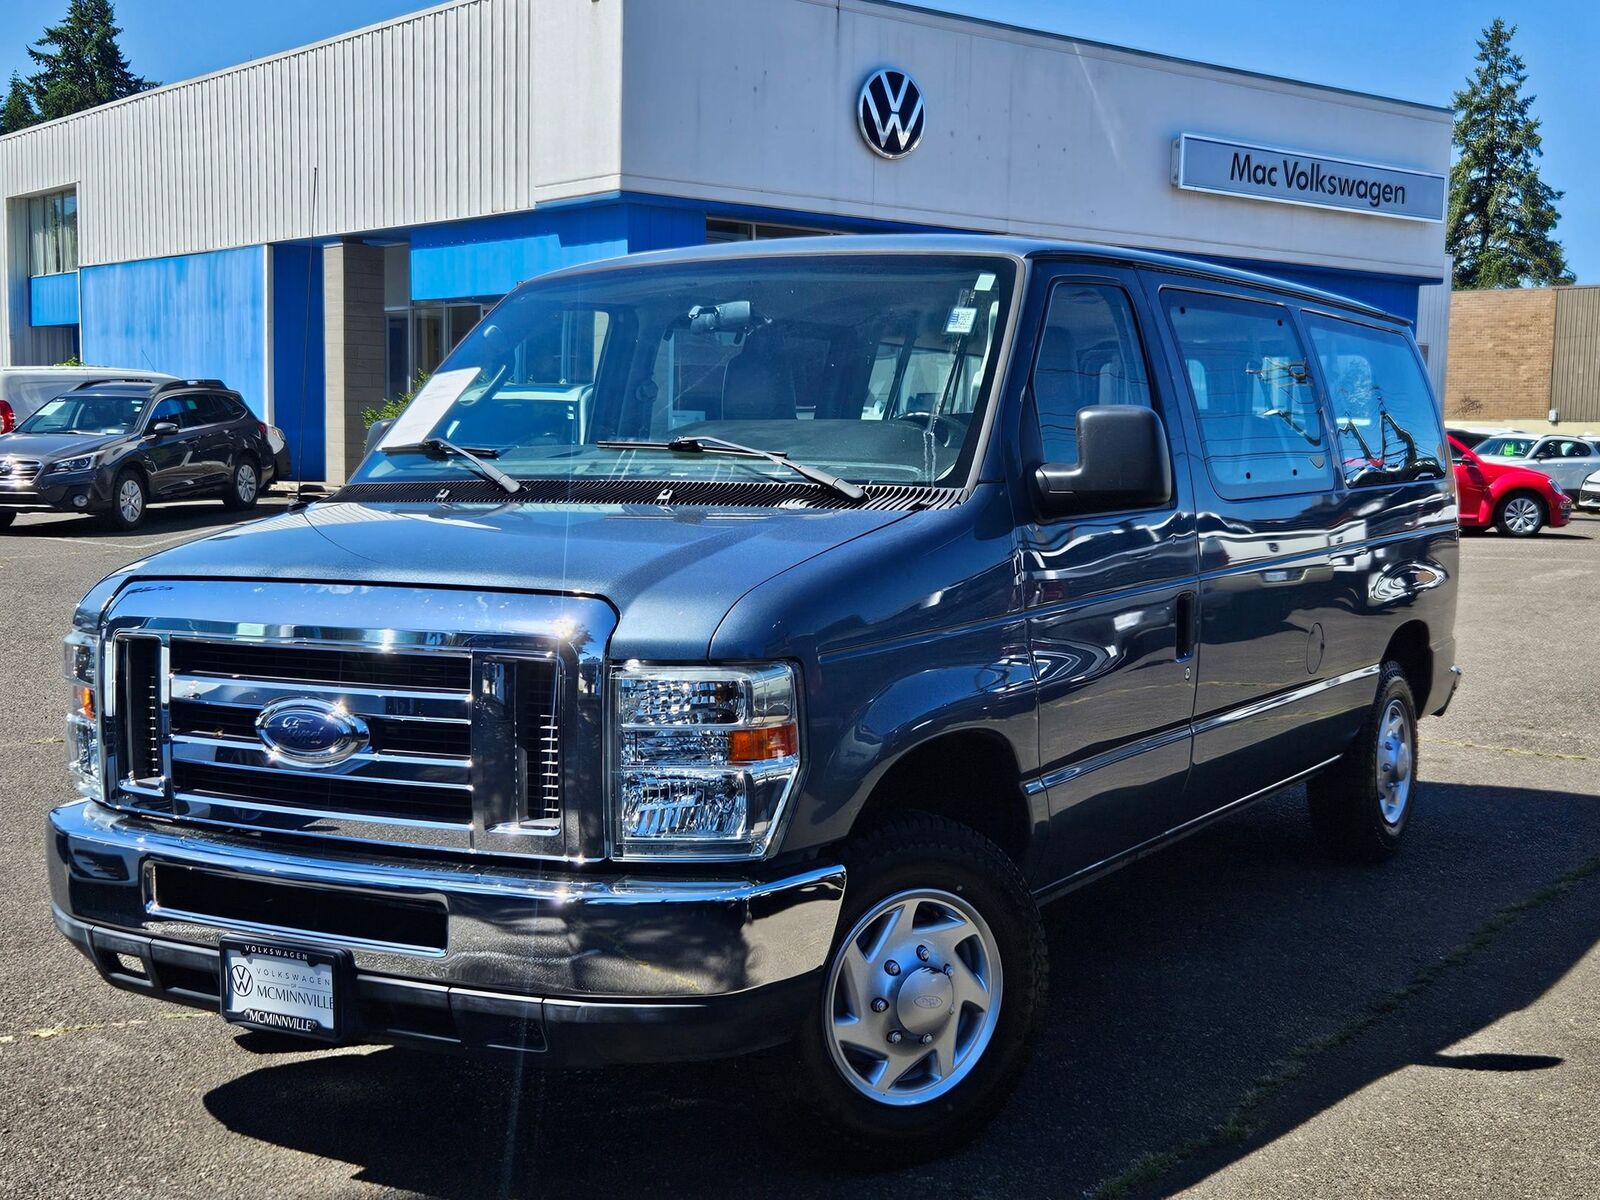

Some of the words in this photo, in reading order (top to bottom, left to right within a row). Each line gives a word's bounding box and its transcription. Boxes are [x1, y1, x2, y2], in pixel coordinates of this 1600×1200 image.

[861, 70, 924, 153] VW
[1230, 152, 1277, 187] Mac
[1283, 159, 1406, 207] Volkswagen
[244, 944, 308, 960] VOLKSWAGEN
[231, 965, 253, 997] VW
[256, 967, 331, 986] VOLKSWAGEN
[256, 985, 334, 1010] MCMINNVILLE
[249, 1010, 312, 1031] MCMINNVILLE
